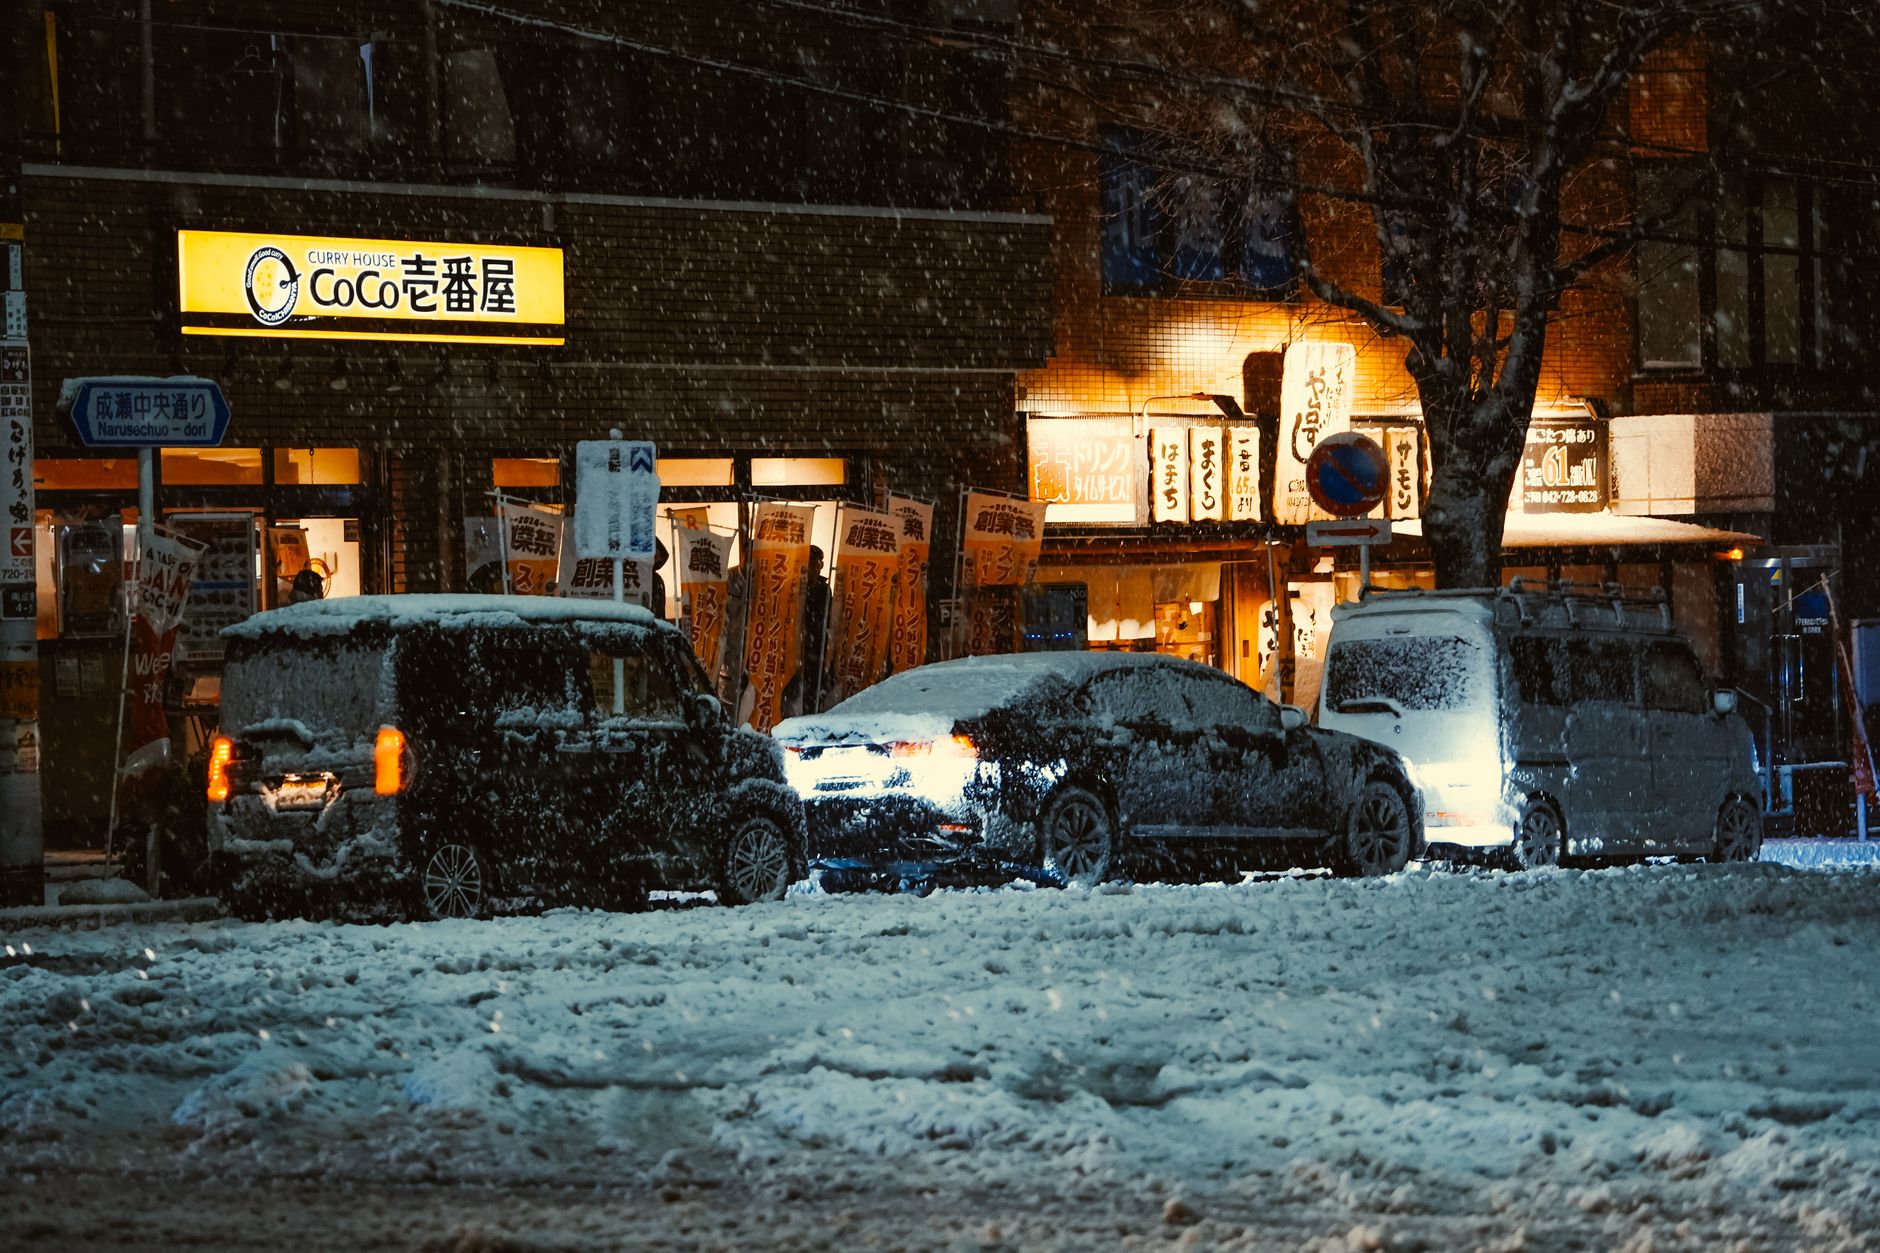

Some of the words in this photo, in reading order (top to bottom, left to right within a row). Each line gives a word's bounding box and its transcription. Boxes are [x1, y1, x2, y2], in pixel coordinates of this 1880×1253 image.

[308, 250, 349, 264] CURRY
[353, 252, 396, 268] HOUSE
[96, 391, 206, 420] 成瀬中央通り
[98, 422, 169, 437] Narusechuo
[184, 421, 206, 437] dori
[1074, 441, 1130, 472] ドリンク
[1161, 443, 1179, 510] はまち
[1201, 439, 1216, 511] まぐろ
[1396, 440, 1413, 510] サーモン
[517, 515, 540, 526] 2024
[775, 511, 793, 519] 2024
[863, 518, 883, 527] 2024
[974, 510, 1036, 540] 創業祭
[757, 518, 805, 544] 創業祭
[845, 524, 897, 553] 創業祭
